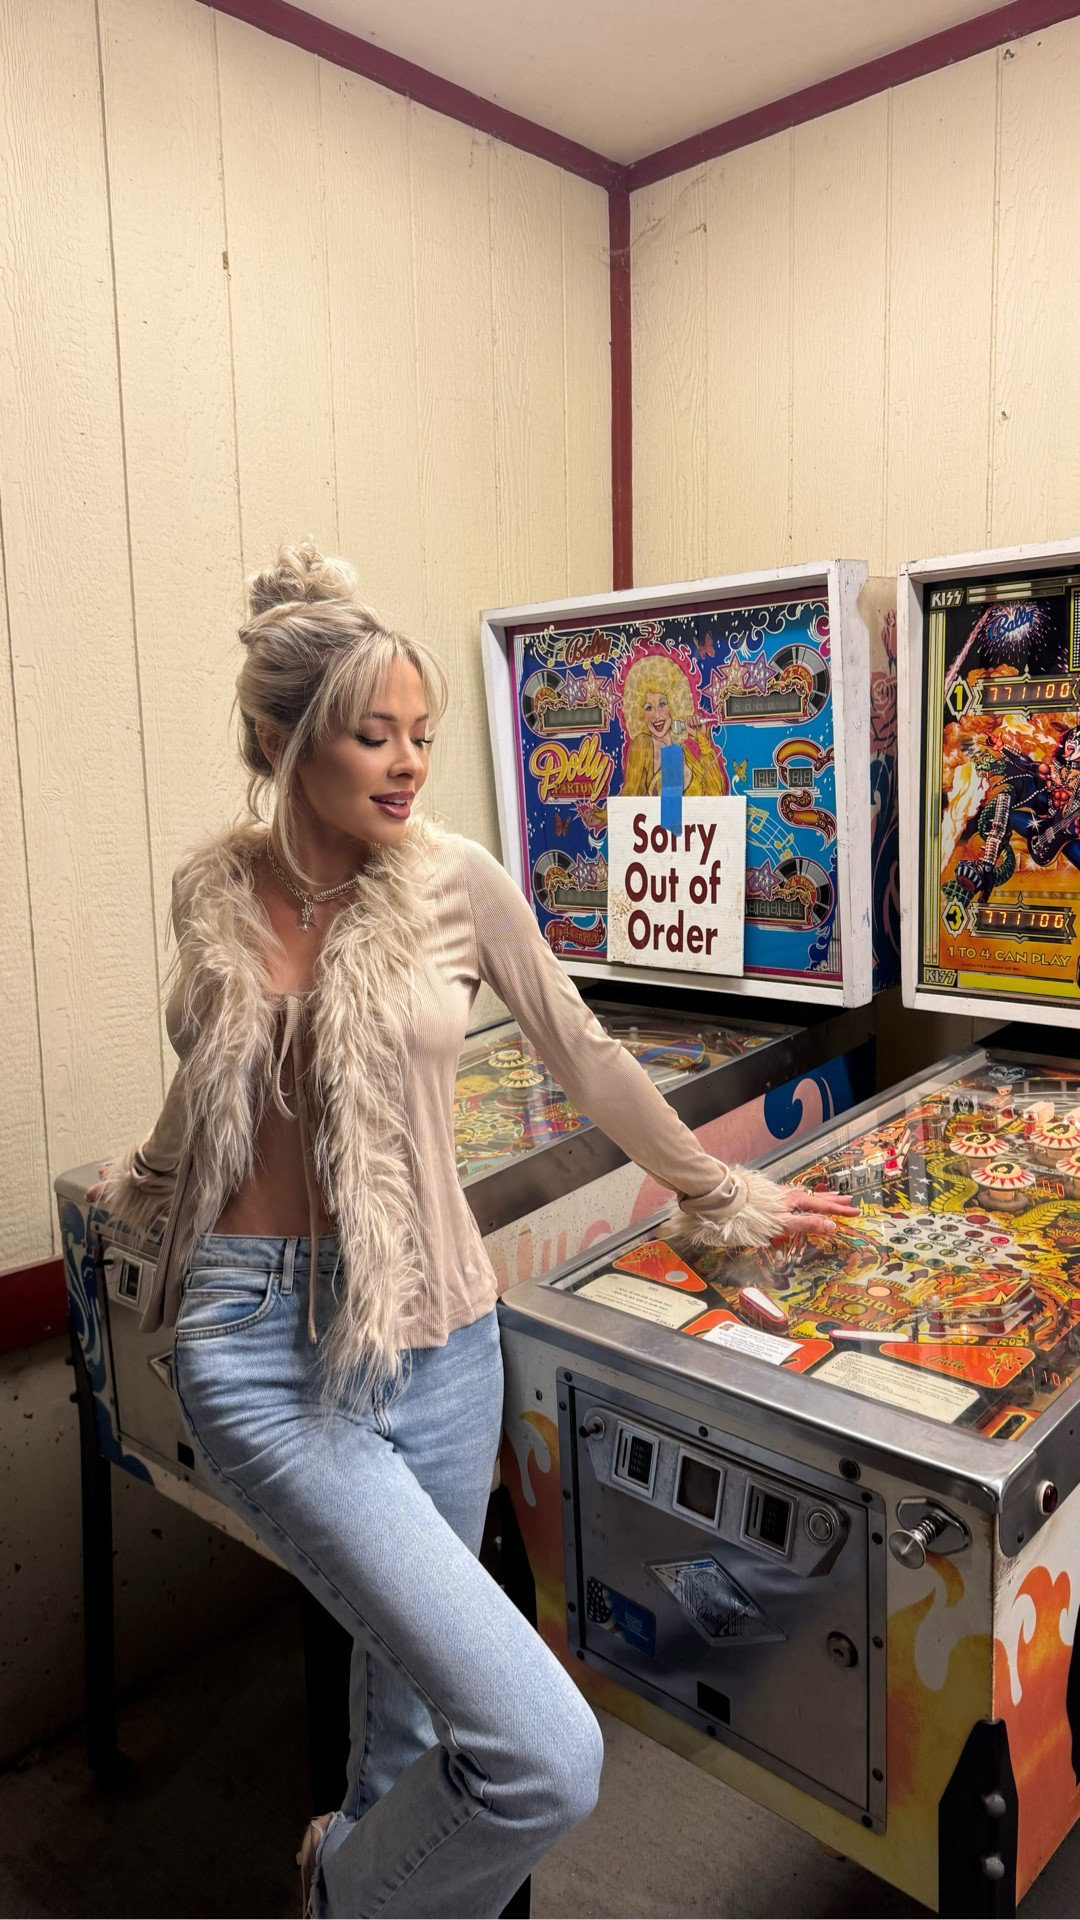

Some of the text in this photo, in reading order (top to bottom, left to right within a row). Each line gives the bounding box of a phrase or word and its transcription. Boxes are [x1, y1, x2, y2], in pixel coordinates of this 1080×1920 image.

[931, 590, 962, 607] KISS
[988, 605, 1035, 642] Bally
[565, 628, 612, 667] Bally
[954, 685, 963, 710] 1
[990, 682, 1070, 701] 771100
[530, 733, 610, 802] Dolly
[554, 782, 595, 795] PARTON
[632, 813, 718, 865] Sorry
[624, 860, 721, 905] Out of
[949, 905, 961, 931] 3
[986, 910, 1064, 928] 771100
[627, 909, 718, 955] Order
[948, 946, 955, 957] 1
[958, 947, 976, 958] TO
[981, 949, 991, 960] 4
[995, 950, 1027, 963] CAN
[1031, 953, 1071, 967] PLAY
[925, 969, 955, 985] KISS
